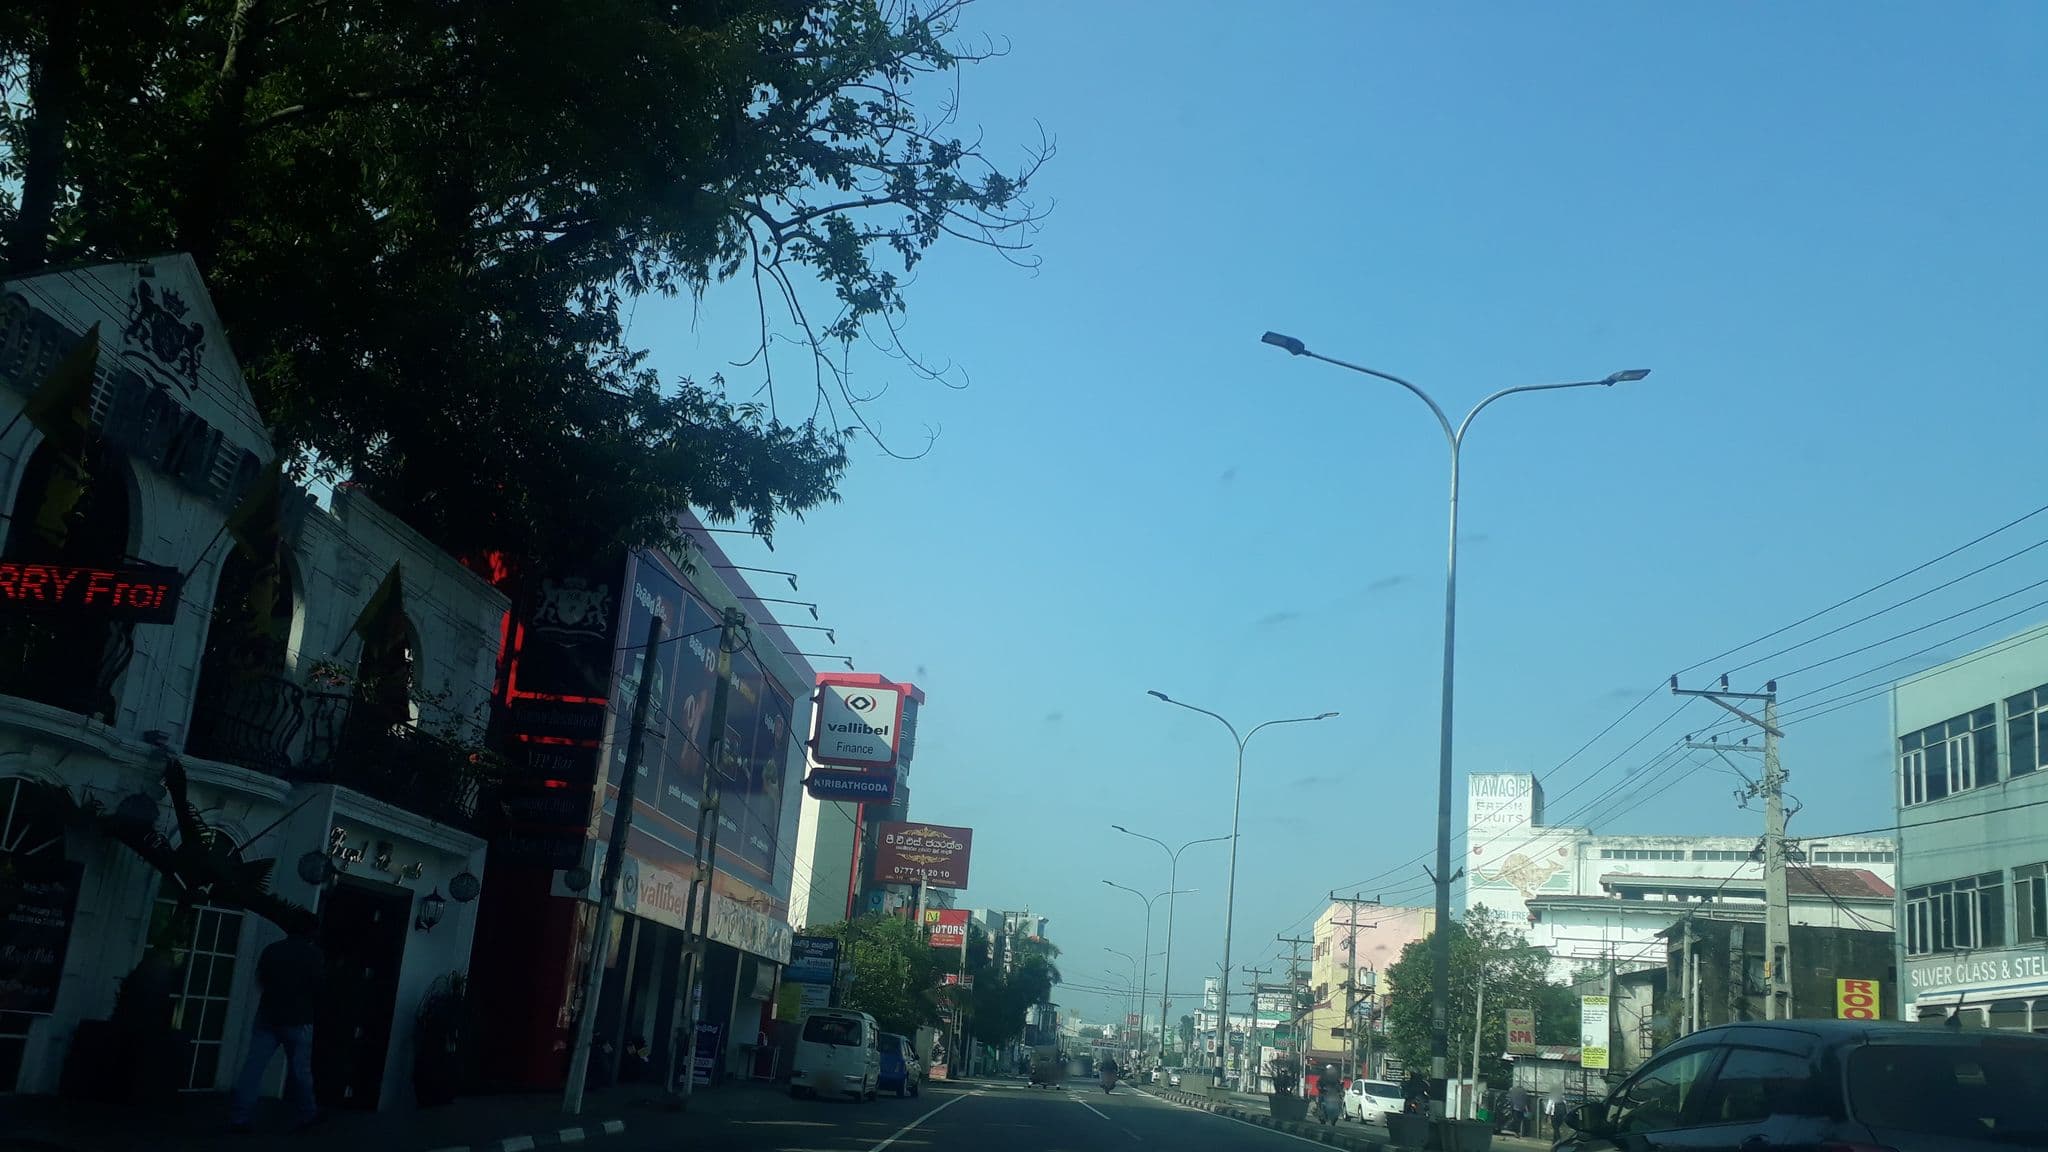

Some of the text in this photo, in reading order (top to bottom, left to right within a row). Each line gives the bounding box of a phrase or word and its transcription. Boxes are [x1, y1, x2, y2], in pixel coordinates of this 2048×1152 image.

[827, 722, 889, 736] vallibel
[836, 741, 874, 755] Finance
[814, 778, 888, 793] KIRIBATHGODA
[1471, 778, 1530, 798] NAWAGIRI
[1476, 801, 1523, 811] FRESH
[1474, 813, 1524, 823] FRUITS
[927, 869, 938, 877] 20
[940, 870, 950, 878] 10
[640, 879, 688, 918] vallibel
[1911, 966, 1952, 988] SILVER
[1956, 962, 1998, 984] GLASS
[2001, 959, 2011, 979] &
[1509, 1030, 1532, 1044] SPA
